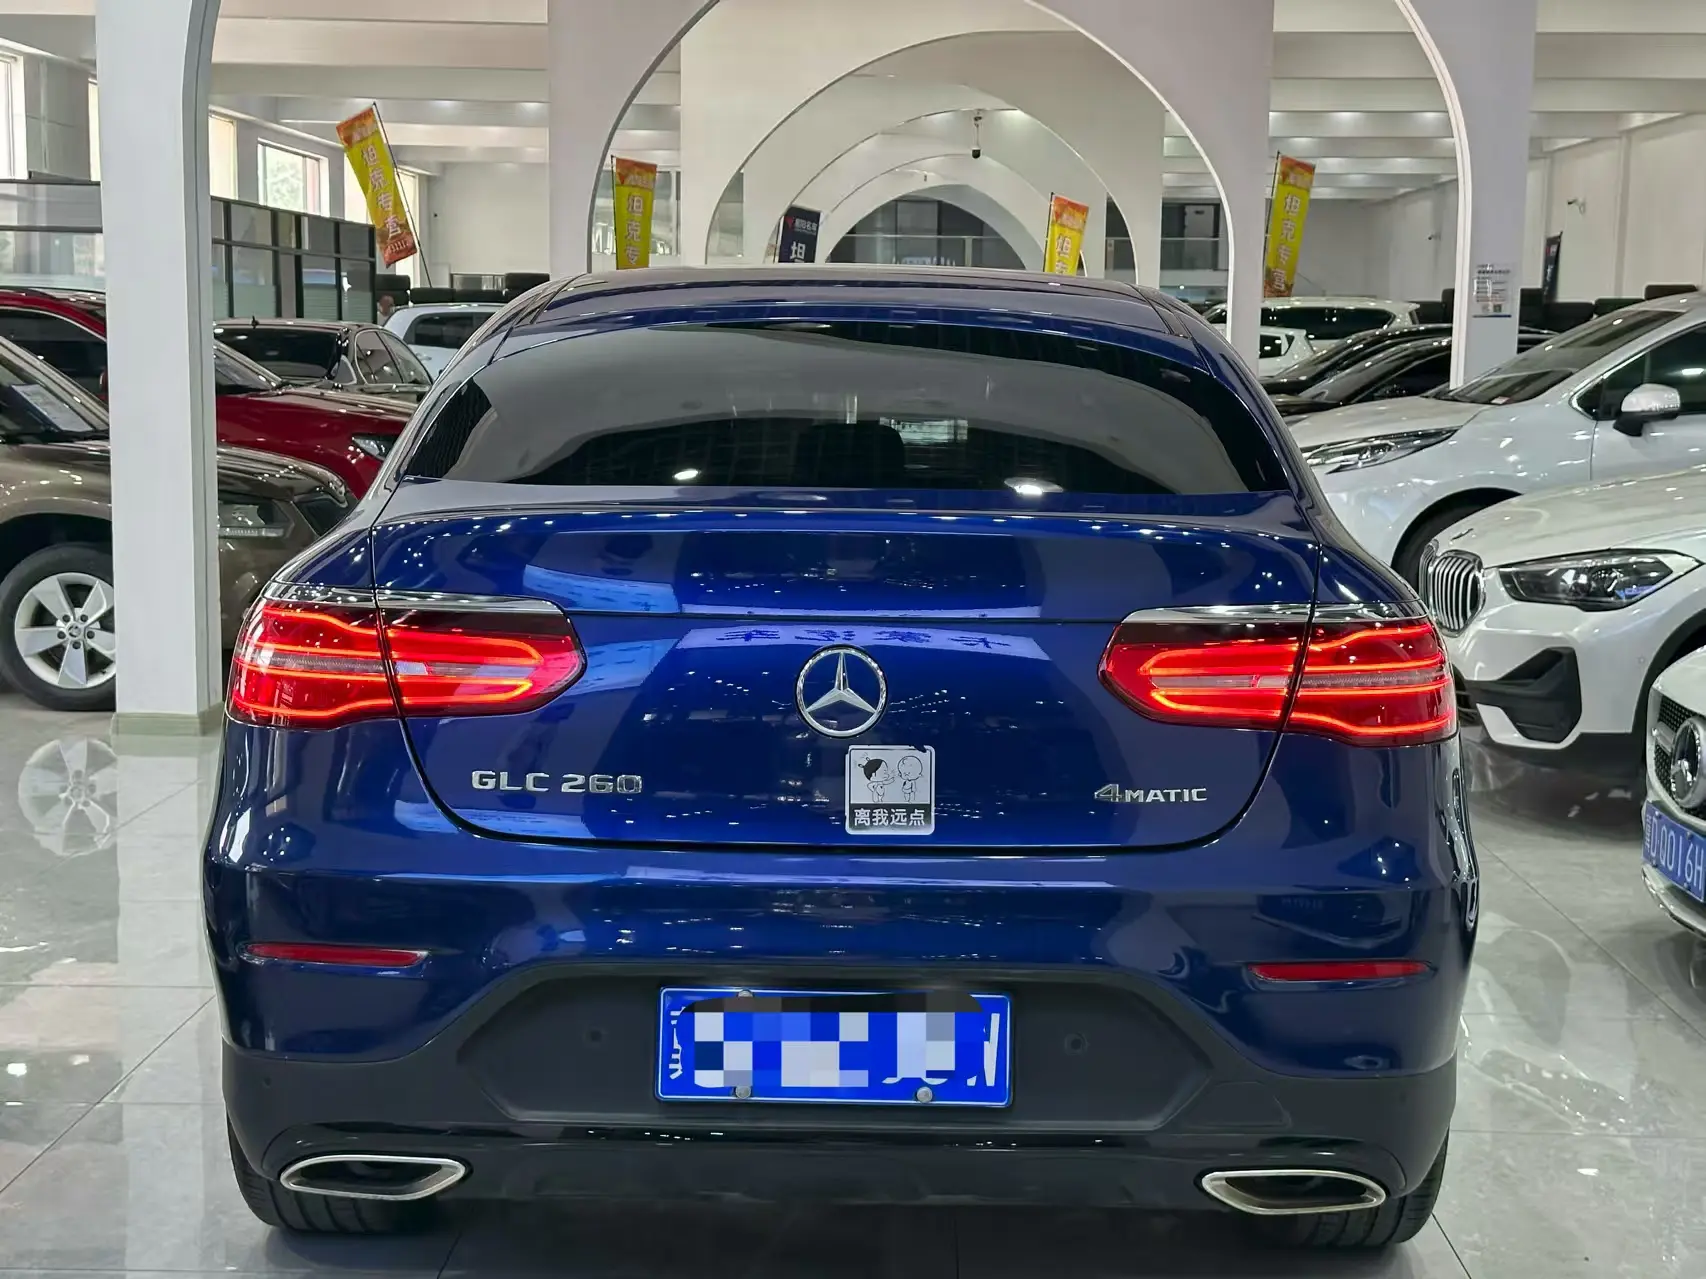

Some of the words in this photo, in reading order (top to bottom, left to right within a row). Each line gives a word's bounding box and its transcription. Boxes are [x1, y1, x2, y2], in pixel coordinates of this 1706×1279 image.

[790, 241, 806, 263] 坦
[472, 770, 549, 792] GLC
[561, 773, 642, 794] 260
[1094, 784, 1207, 803] 4MATIC
[854, 808, 925, 826] 离我远点
